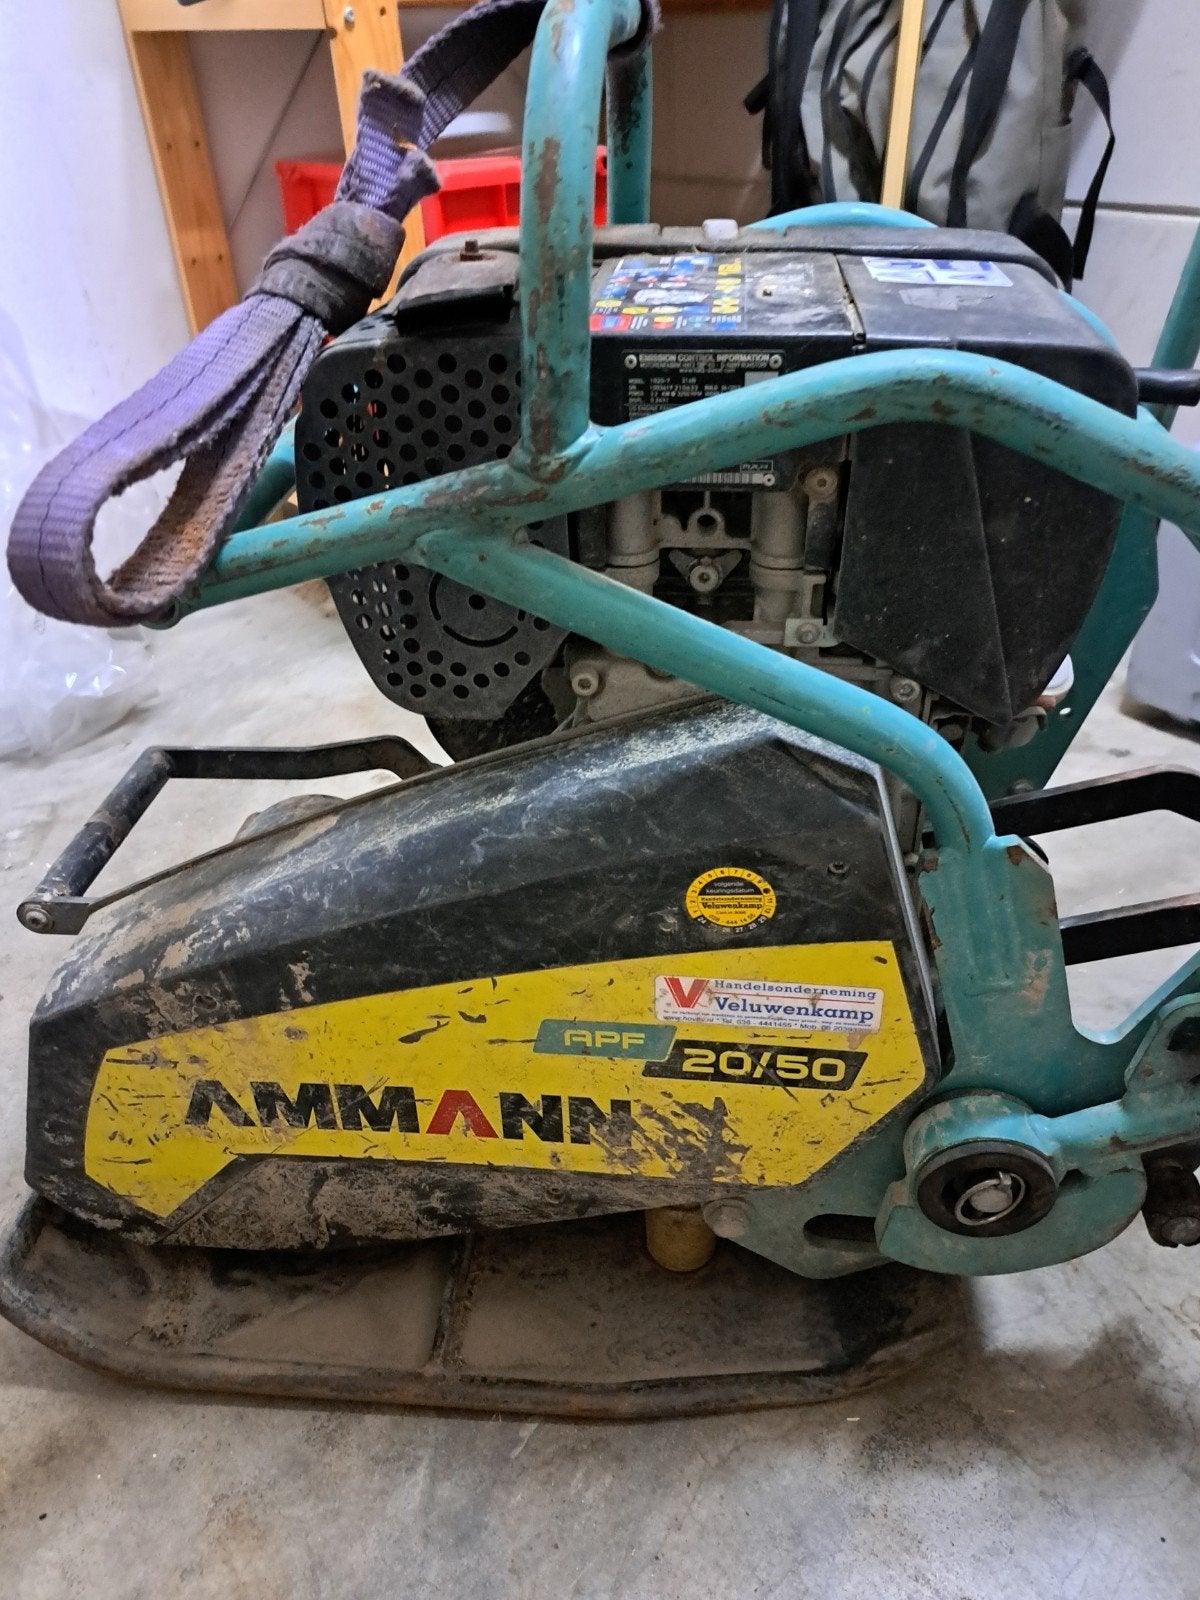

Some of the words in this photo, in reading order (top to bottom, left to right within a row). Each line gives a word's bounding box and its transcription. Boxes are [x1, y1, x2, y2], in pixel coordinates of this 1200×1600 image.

[702, 902, 762, 910] Veluwenkamp
[664, 977, 709, 1009] V
[715, 980, 876, 1000] Handelsonderneming
[714, 997, 874, 1024] Veluwenkamp
[563, 1029, 645, 1049] APF
[683, 1048, 846, 1082] 20/50
[184, 1080, 632, 1146] AMMANN
